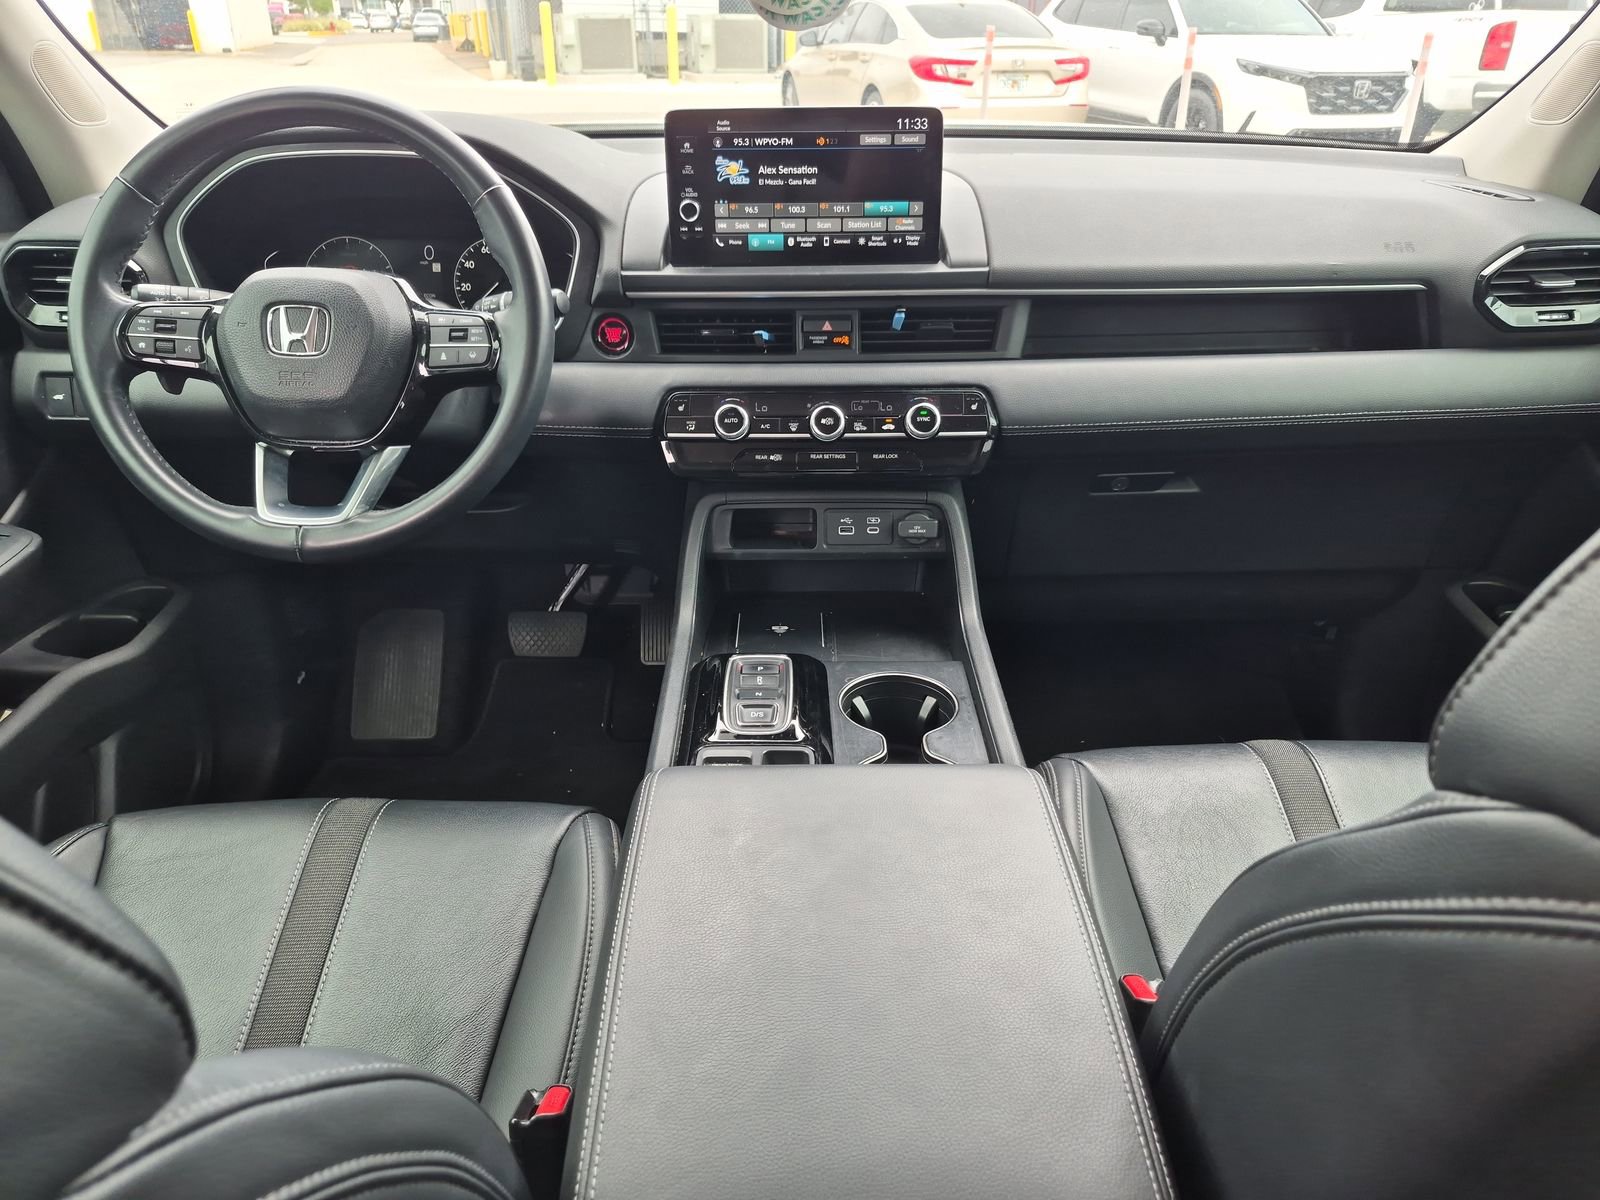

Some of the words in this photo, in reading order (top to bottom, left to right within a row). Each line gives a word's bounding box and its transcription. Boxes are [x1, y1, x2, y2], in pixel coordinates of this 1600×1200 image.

[896, 118, 928, 130] 11:33
[733, 138, 750, 147] 95.3
[754, 138, 793, 147] WPYO-FM
[864, 135, 887, 144] Settings
[901, 135, 919, 143] Sound
[758, 165, 777, 175] Alex
[778, 165, 818, 175] Sensation
[744, 206, 759, 214] 96.5
[788, 206, 806, 214] 100.3
[833, 205, 850, 213] 101.1
[879, 205, 894, 213] 95.3
[735, 221, 750, 229] Seek
[780, 221, 796, 229] Tune
[816, 221, 832, 229] Scan
[848, 220, 869, 229] Station
[870, 220, 882, 229] List
[424, 245, 434, 260] 0
[461, 283, 471, 291] 20
